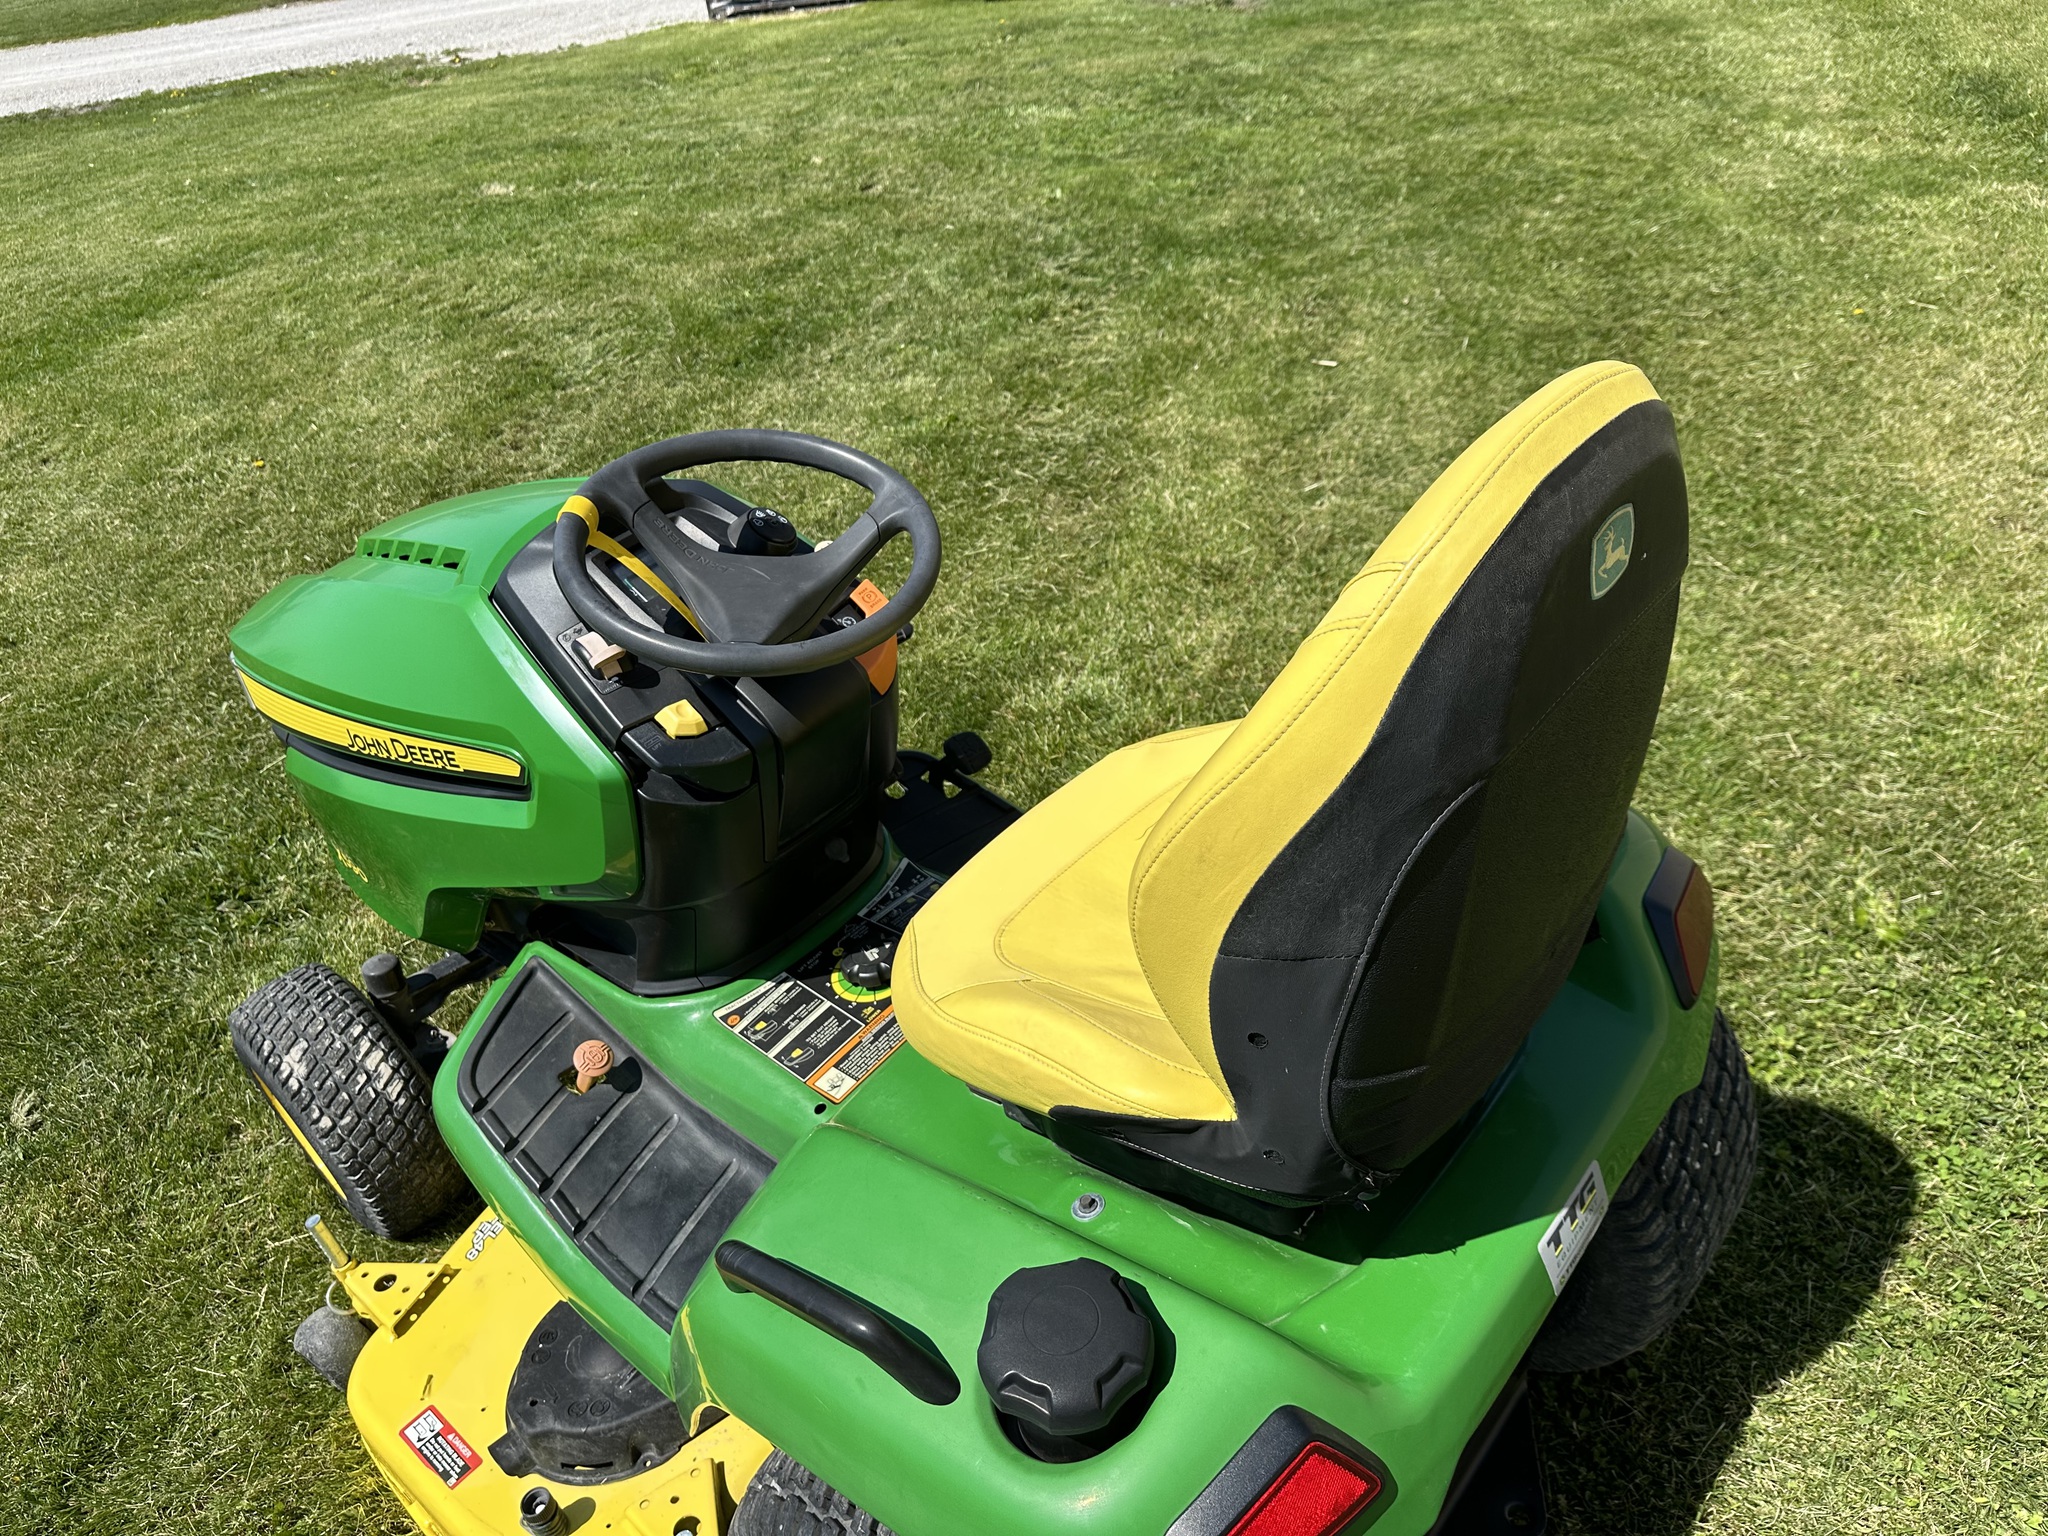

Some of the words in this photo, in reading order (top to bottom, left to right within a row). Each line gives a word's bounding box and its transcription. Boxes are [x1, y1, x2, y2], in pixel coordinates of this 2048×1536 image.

[653, 517, 697, 558] DEERE
[346, 729, 392, 757] JOHN
[390, 738, 461, 769] DEERE
[1547, 1171, 1597, 1257] TTG
[452, 1436, 472, 1458] DANGER
